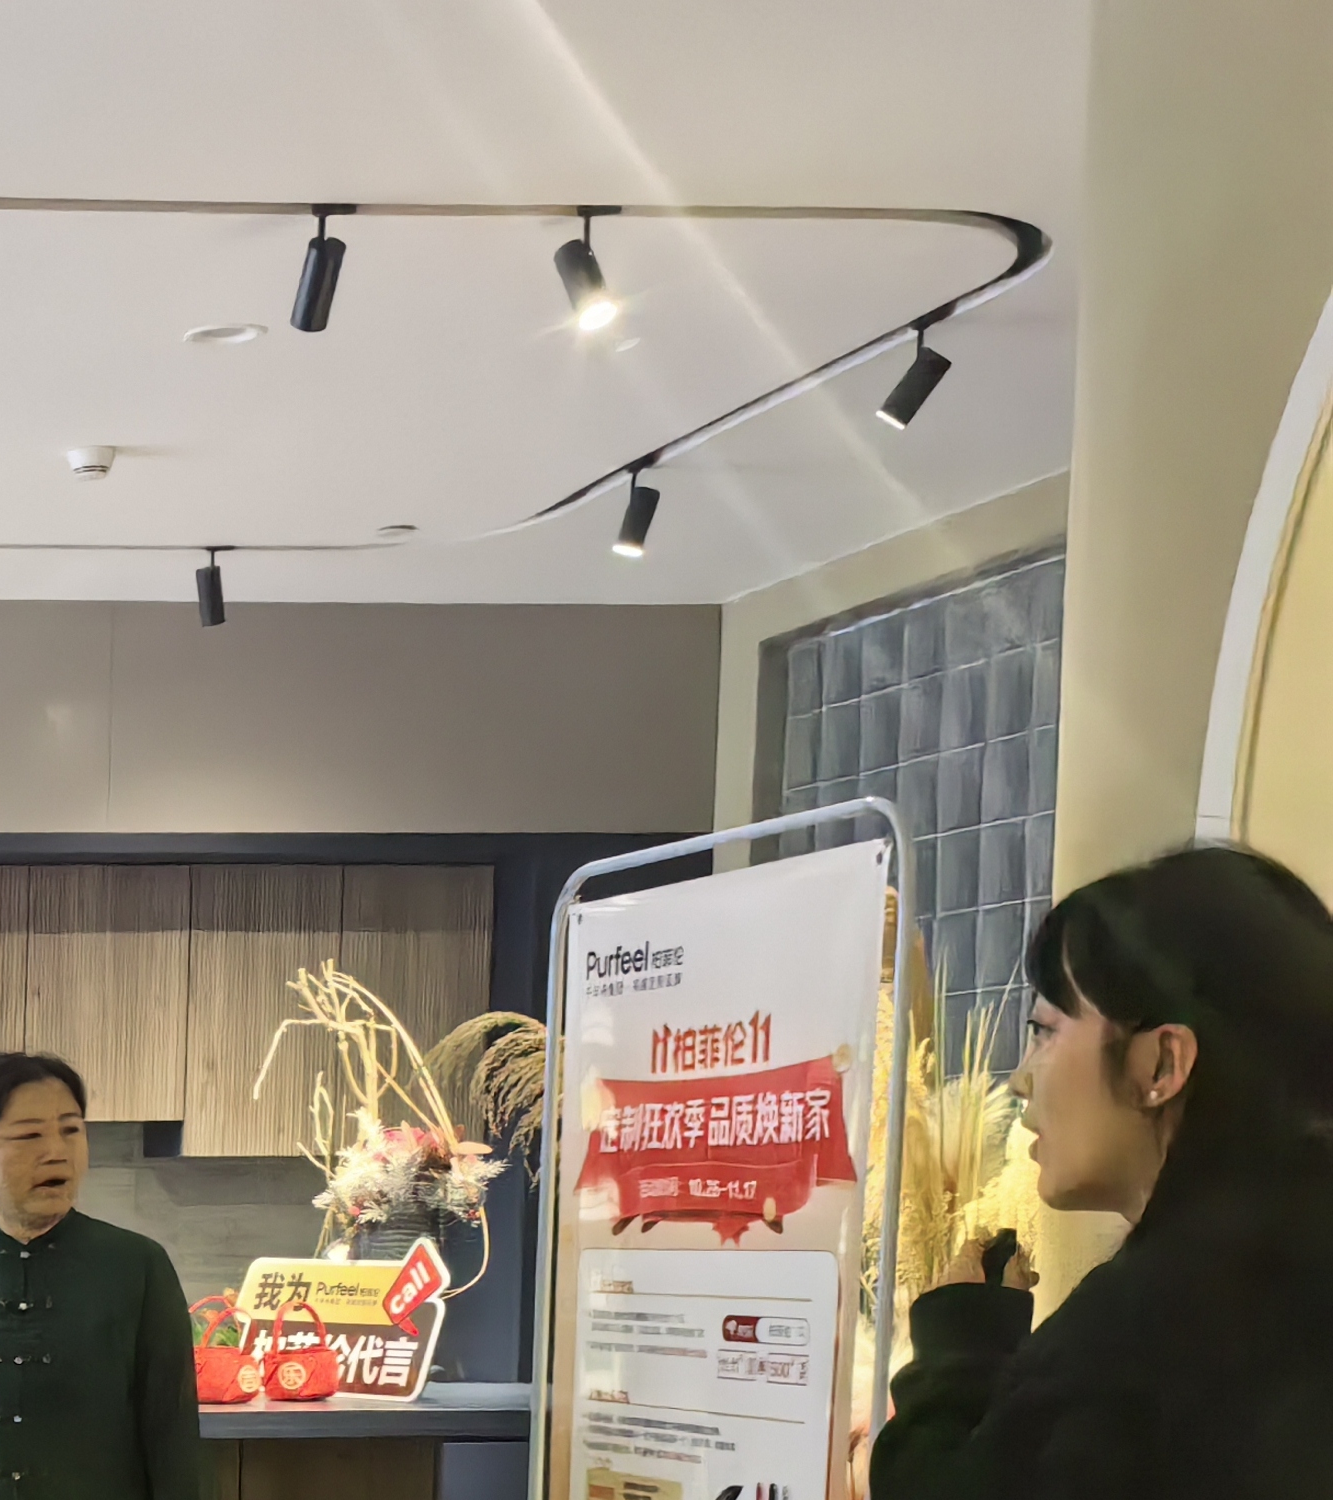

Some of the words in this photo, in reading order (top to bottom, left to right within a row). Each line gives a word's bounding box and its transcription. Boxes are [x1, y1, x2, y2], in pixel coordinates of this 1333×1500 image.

[586, 940, 650, 981] Purfeel
[315, 1281, 361, 1297] Purfeel
[389, 1260, 432, 1316] call
